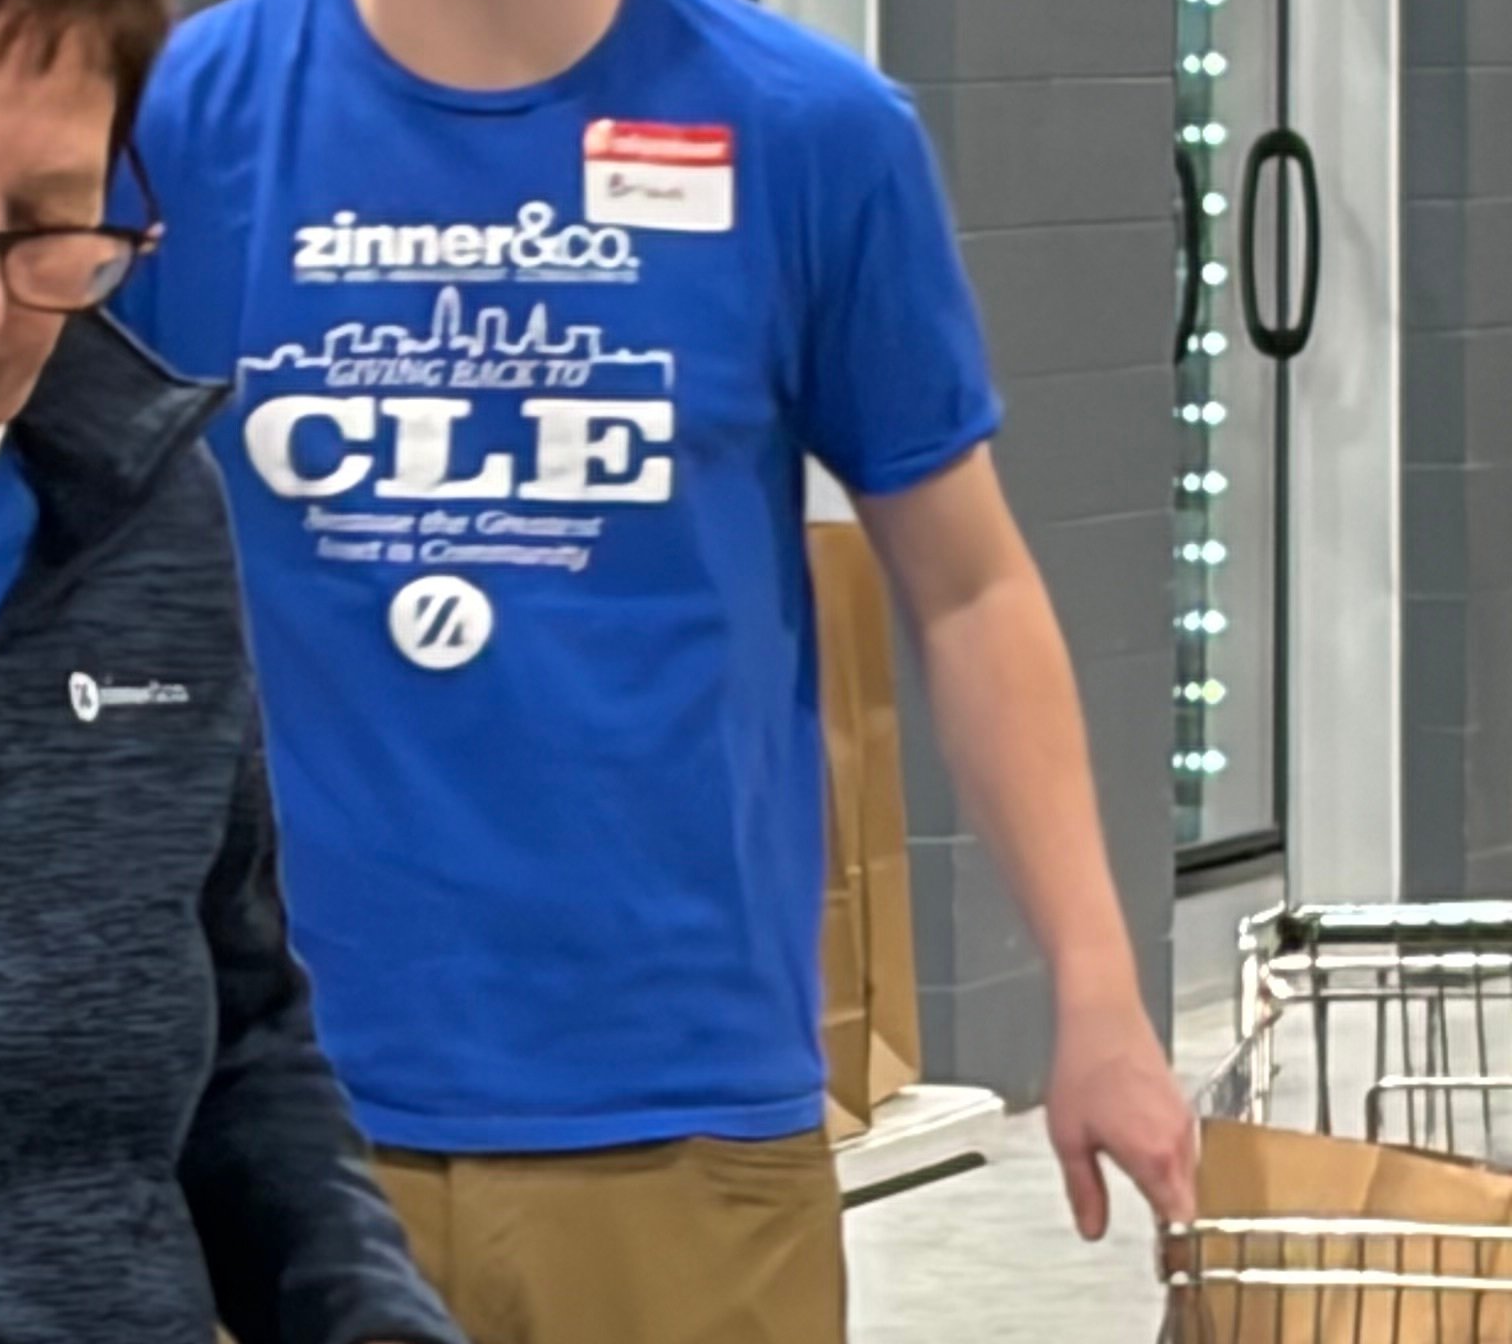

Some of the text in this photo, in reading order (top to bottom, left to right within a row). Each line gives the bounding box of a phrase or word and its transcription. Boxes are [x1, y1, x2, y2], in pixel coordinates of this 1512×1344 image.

[294, 202, 640, 268] zinner&co.
[326, 359, 590, 387] GIVING BACK TO
[244, 394, 674, 502] CLE
